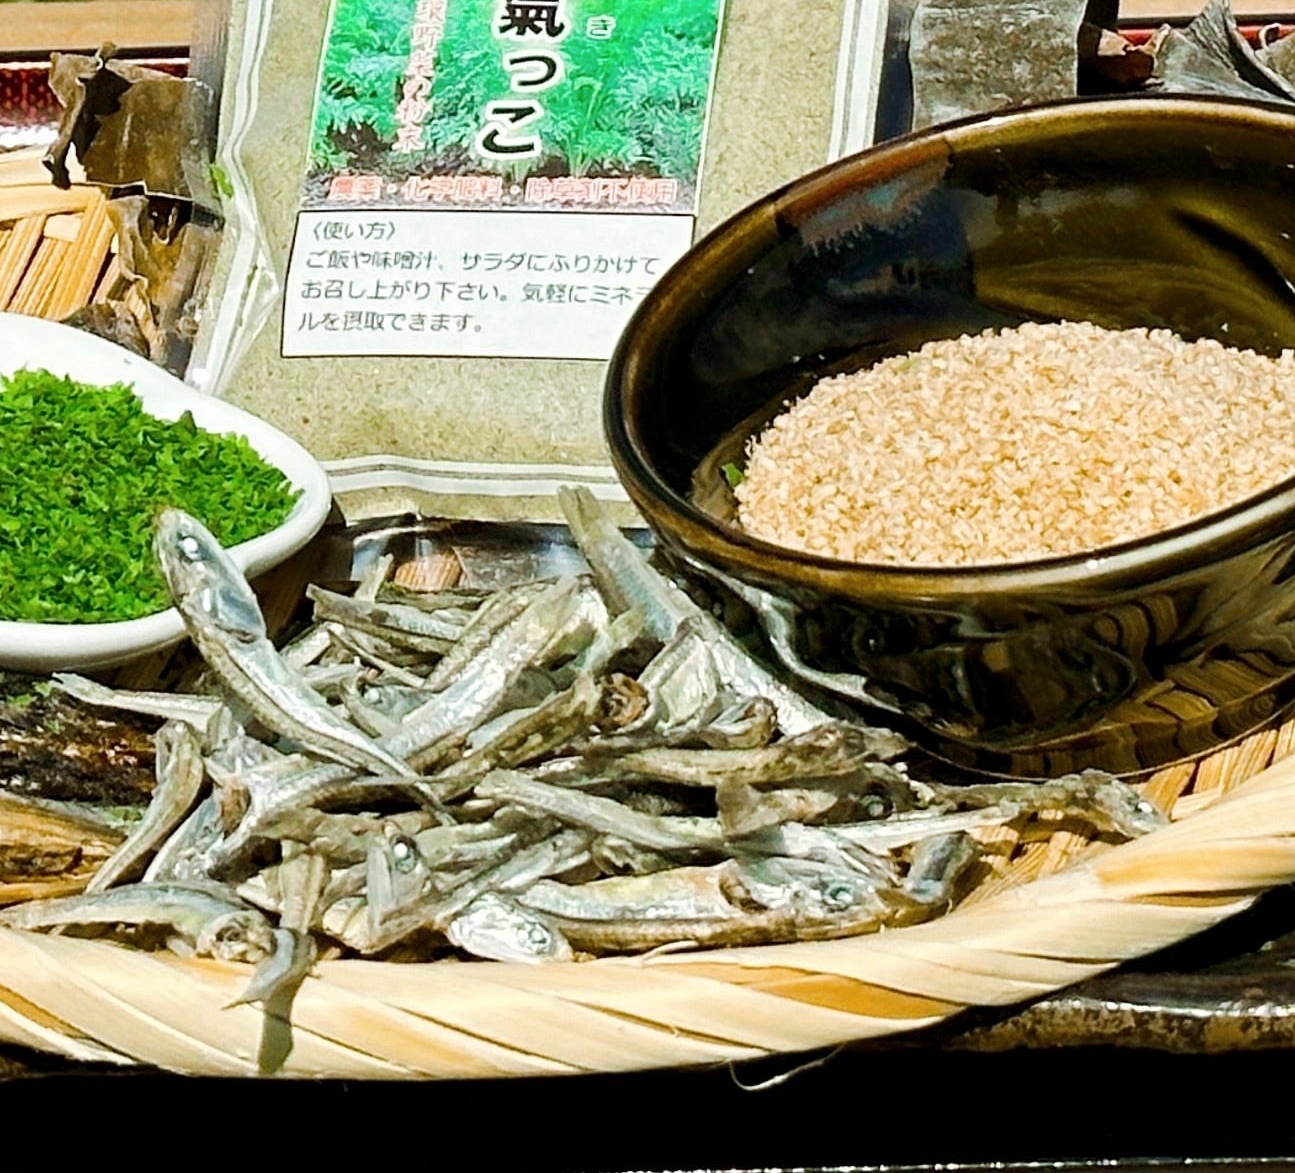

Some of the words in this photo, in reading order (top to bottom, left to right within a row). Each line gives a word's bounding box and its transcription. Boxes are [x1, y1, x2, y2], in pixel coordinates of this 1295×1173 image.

[306, 251, 660, 276] ご飯や味噌汁、サラダにふりかけて
[297, 310, 484, 333] ルを摂取できます。
